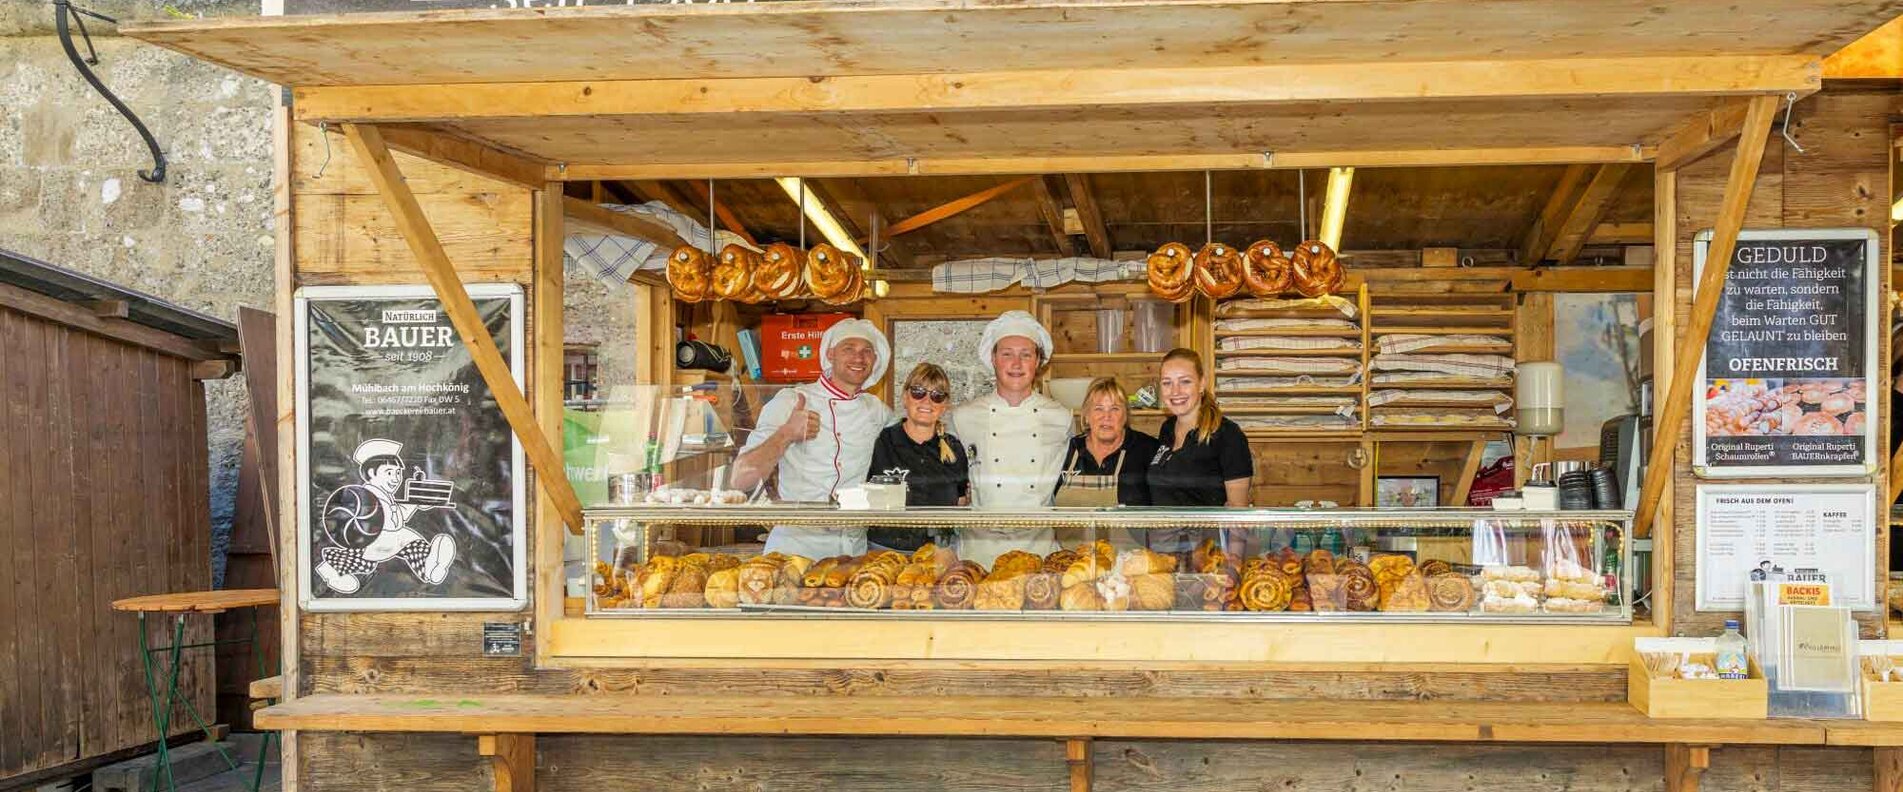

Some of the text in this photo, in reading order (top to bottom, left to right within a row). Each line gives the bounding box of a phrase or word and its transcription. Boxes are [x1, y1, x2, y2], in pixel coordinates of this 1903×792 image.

[1737, 246, 1827, 264] GEDULD
[1724, 267, 1847, 281] st nicht die Fähigkeit
[1727, 284, 1839, 296] zu warten, sondern
[1745, 299, 1823, 312] die Fähigkeit,
[1732, 314, 1838, 326] beim Warten GUT
[363, 326, 455, 348] BAUER
[781, 330, 824, 340] Erste Hilf
[1721, 330, 1847, 342] GELAUNT zu bleiben
[384, 351, 434, 362] seit 1908
[1729, 357, 1839, 372] OFENFRISCH
[351, 382, 470, 394] Mühlbach am Hochkönig
[438, 395, 454, 404] DW
[1711, 443, 1774, 452] Original Ruperti
[1792, 443, 1856, 452] Original Ruperti
[1716, 497, 1739, 505] FRISCH
[1741, 497, 1755, 505] AUS
[1756, 497, 1771, 505] DEM
[1823, 511, 1848, 519] KAFFEE
